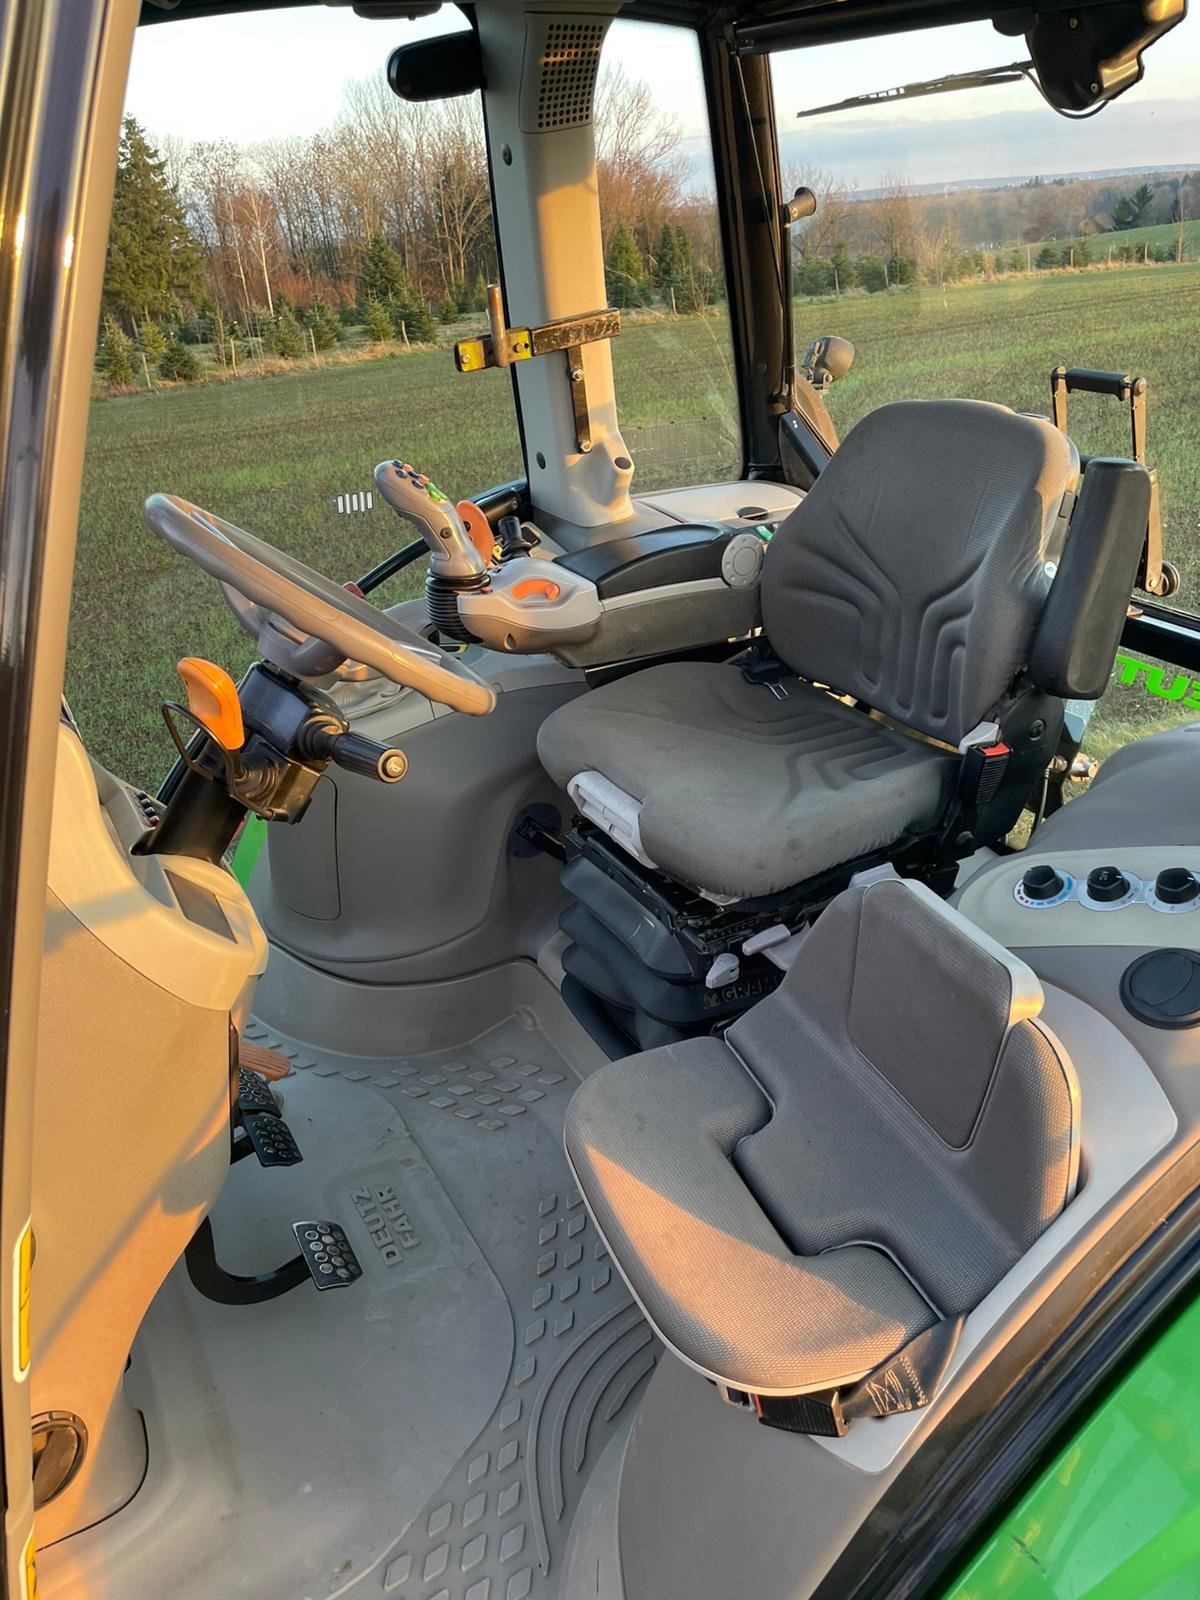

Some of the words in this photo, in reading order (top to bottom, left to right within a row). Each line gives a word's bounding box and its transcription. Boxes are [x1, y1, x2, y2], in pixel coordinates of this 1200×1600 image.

[721, 975, 783, 1002] GRAM
[350, 1185, 403, 1267] DEUTZ
[376, 1185, 420, 1249] FAHR
